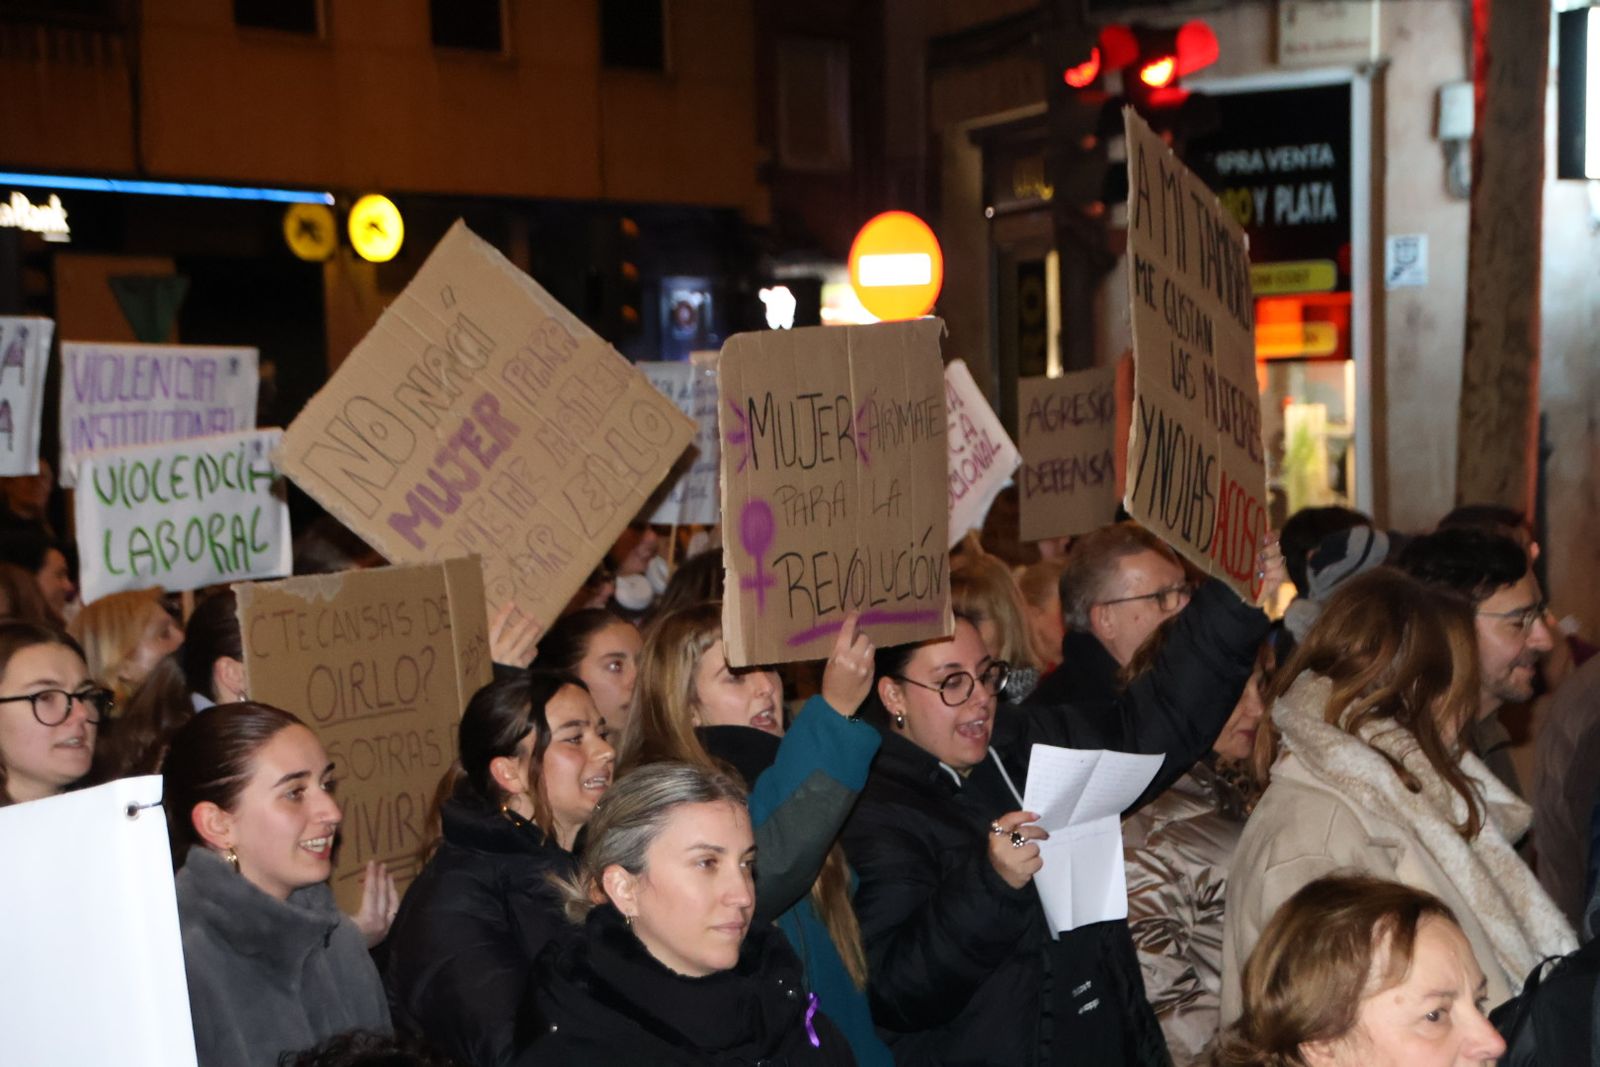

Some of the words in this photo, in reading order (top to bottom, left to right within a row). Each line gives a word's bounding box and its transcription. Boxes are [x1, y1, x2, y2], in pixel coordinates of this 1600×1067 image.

[1135, 142, 1153, 241] A
[1216, 149, 1264, 175] PRA
[1265, 142, 1336, 172] VENTA
[1253, 186, 1268, 227] Y
[1274, 182, 1337, 224] PLATA
[1135, 252, 1158, 312] ME
[71, 351, 218, 403] VIOLENCIA
[1169, 341, 1197, 401] LAS
[301, 394, 418, 520] NO
[748, 391, 858, 471] MUJER
[1132, 393, 1155, 502] Y
[92, 442, 279, 508] VIOLENCIA
[386, 391, 522, 551] MUJER
[561, 399, 674, 540] ELLO
[772, 479, 846, 528] PARA
[871, 479, 902, 518] LA
[103, 506, 270, 577] LABORAL
[772, 526, 945, 622] REVOLUCIÓN
[305, 645, 437, 724] OIRLO?
